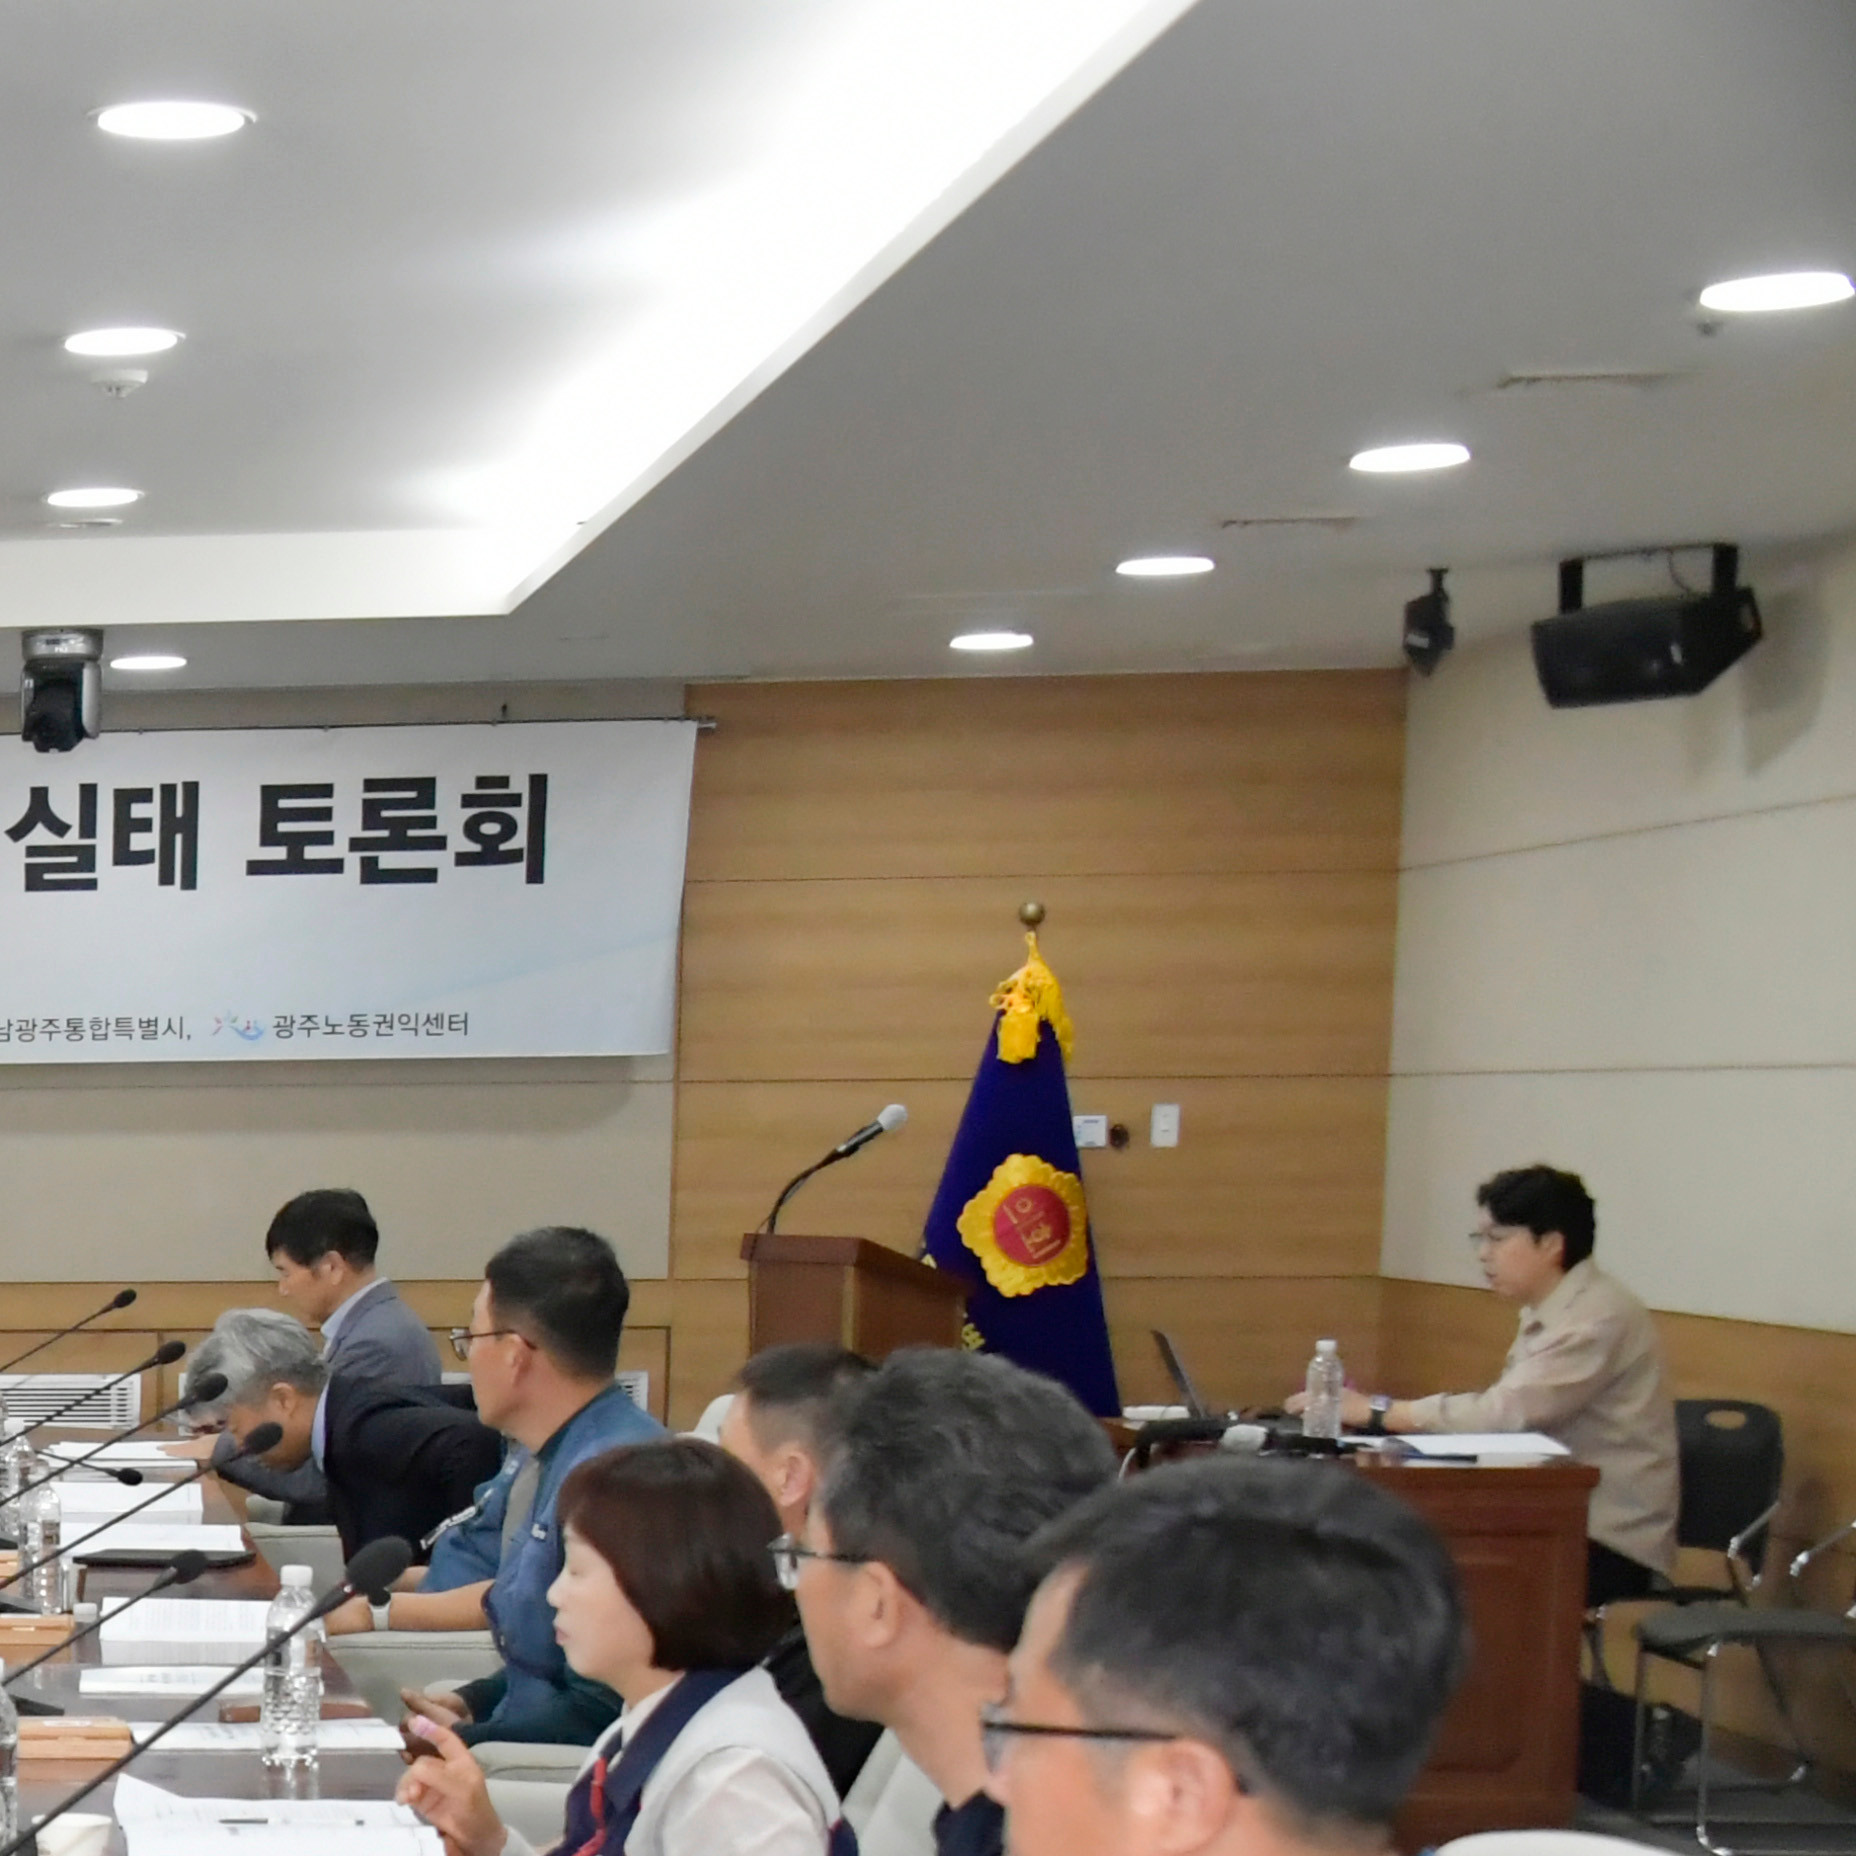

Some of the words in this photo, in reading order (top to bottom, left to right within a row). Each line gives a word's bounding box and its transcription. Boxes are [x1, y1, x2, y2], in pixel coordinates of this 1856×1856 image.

[4, 780, 200, 893] 실태
[245, 772, 549, 885] 토론회
[273, 1011, 469, 1040] 광주노동권익센터
